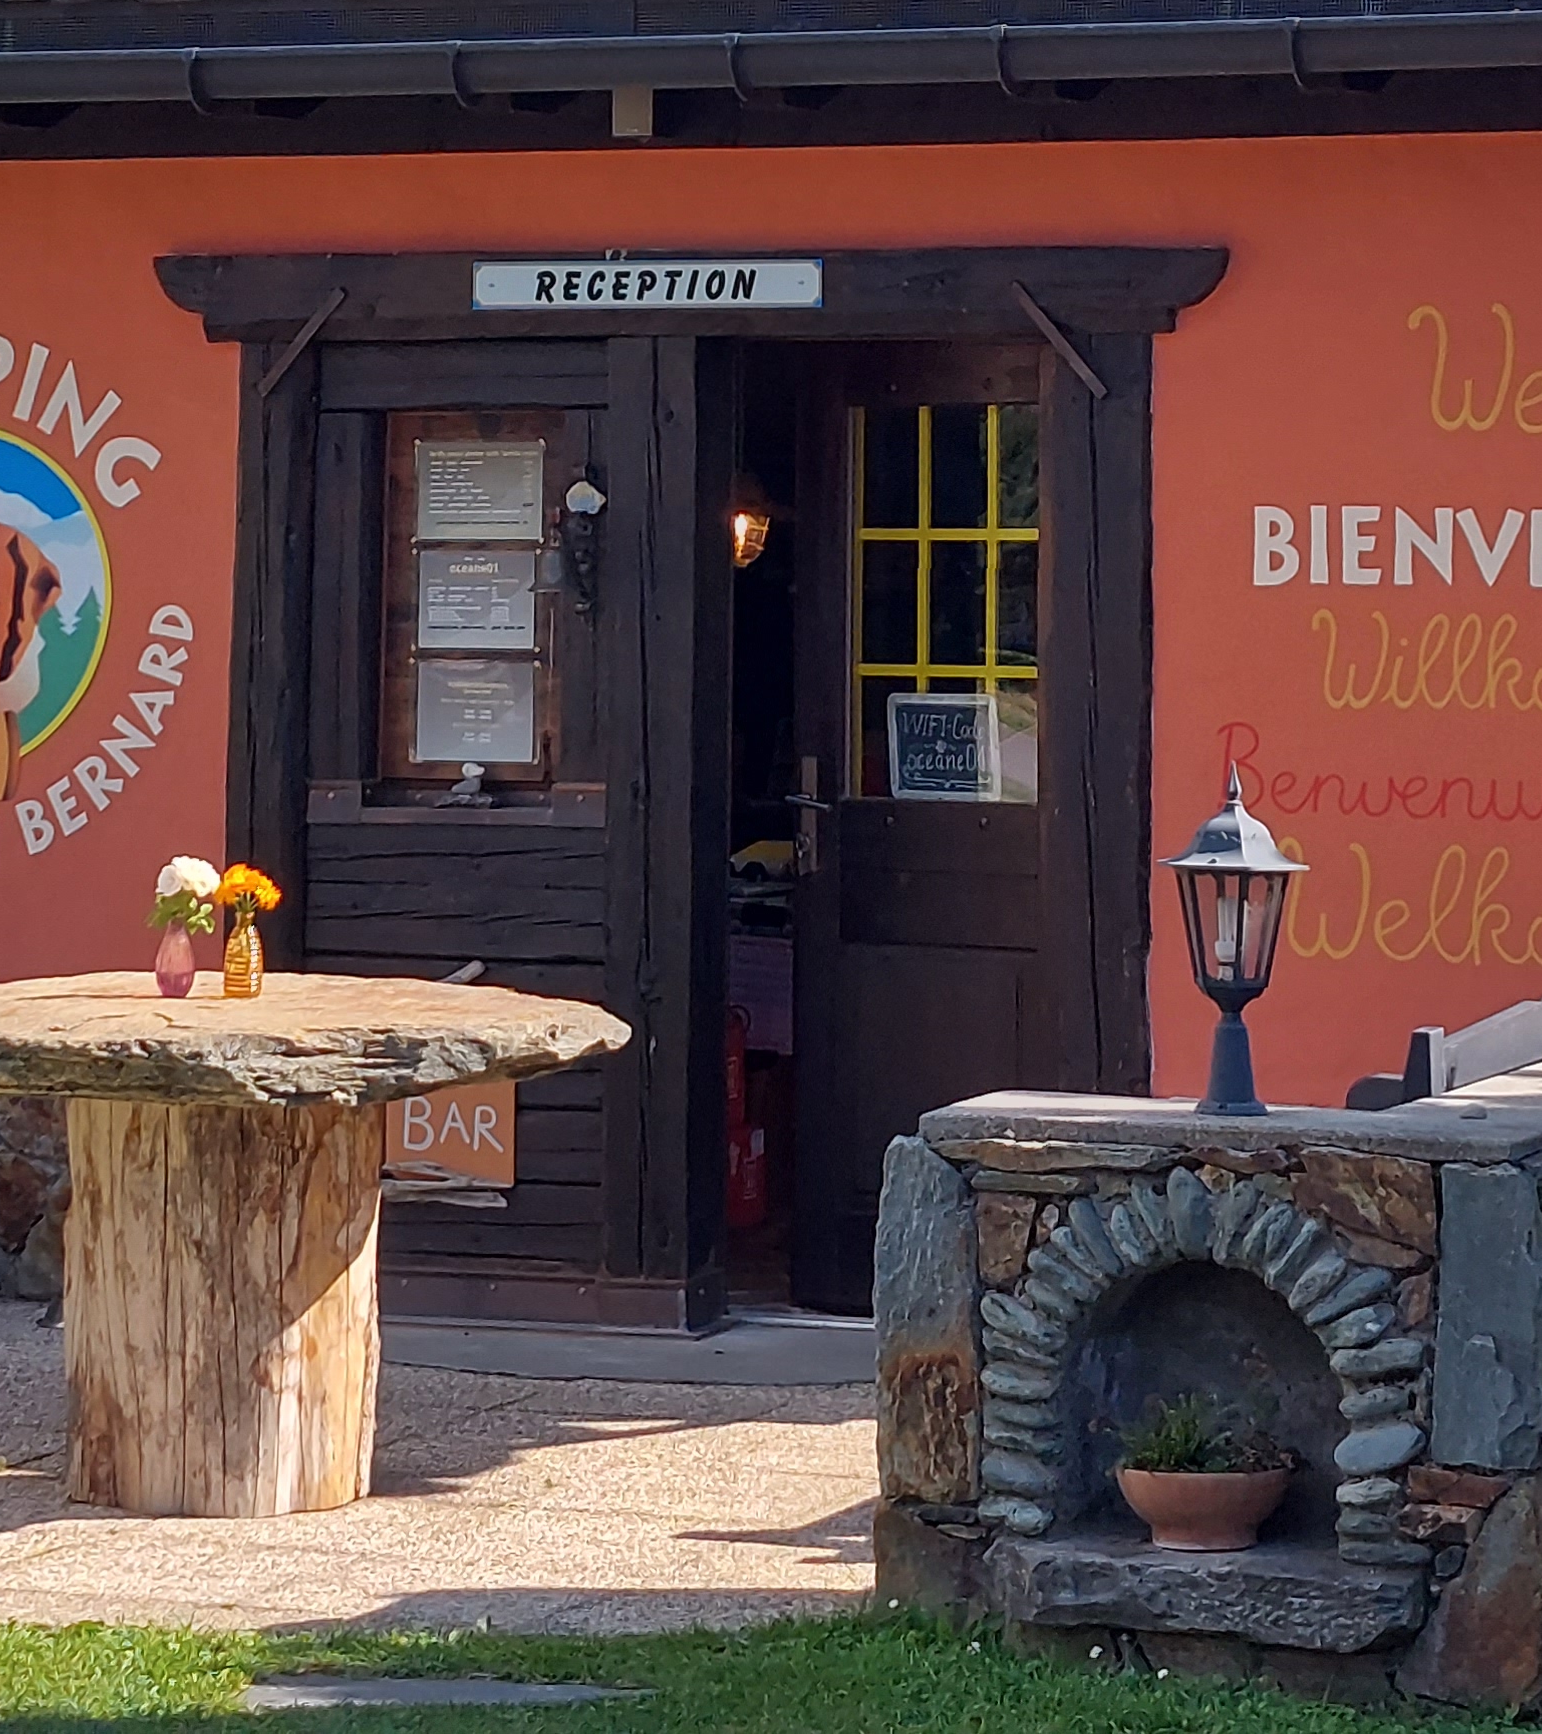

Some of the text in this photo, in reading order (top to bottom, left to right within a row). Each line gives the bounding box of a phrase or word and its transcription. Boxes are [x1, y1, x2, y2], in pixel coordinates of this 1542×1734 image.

[535, 269, 756, 303] RECEPTION
[16, 604, 194, 856] BERNARD
[403, 1096, 504, 1153] BAR
